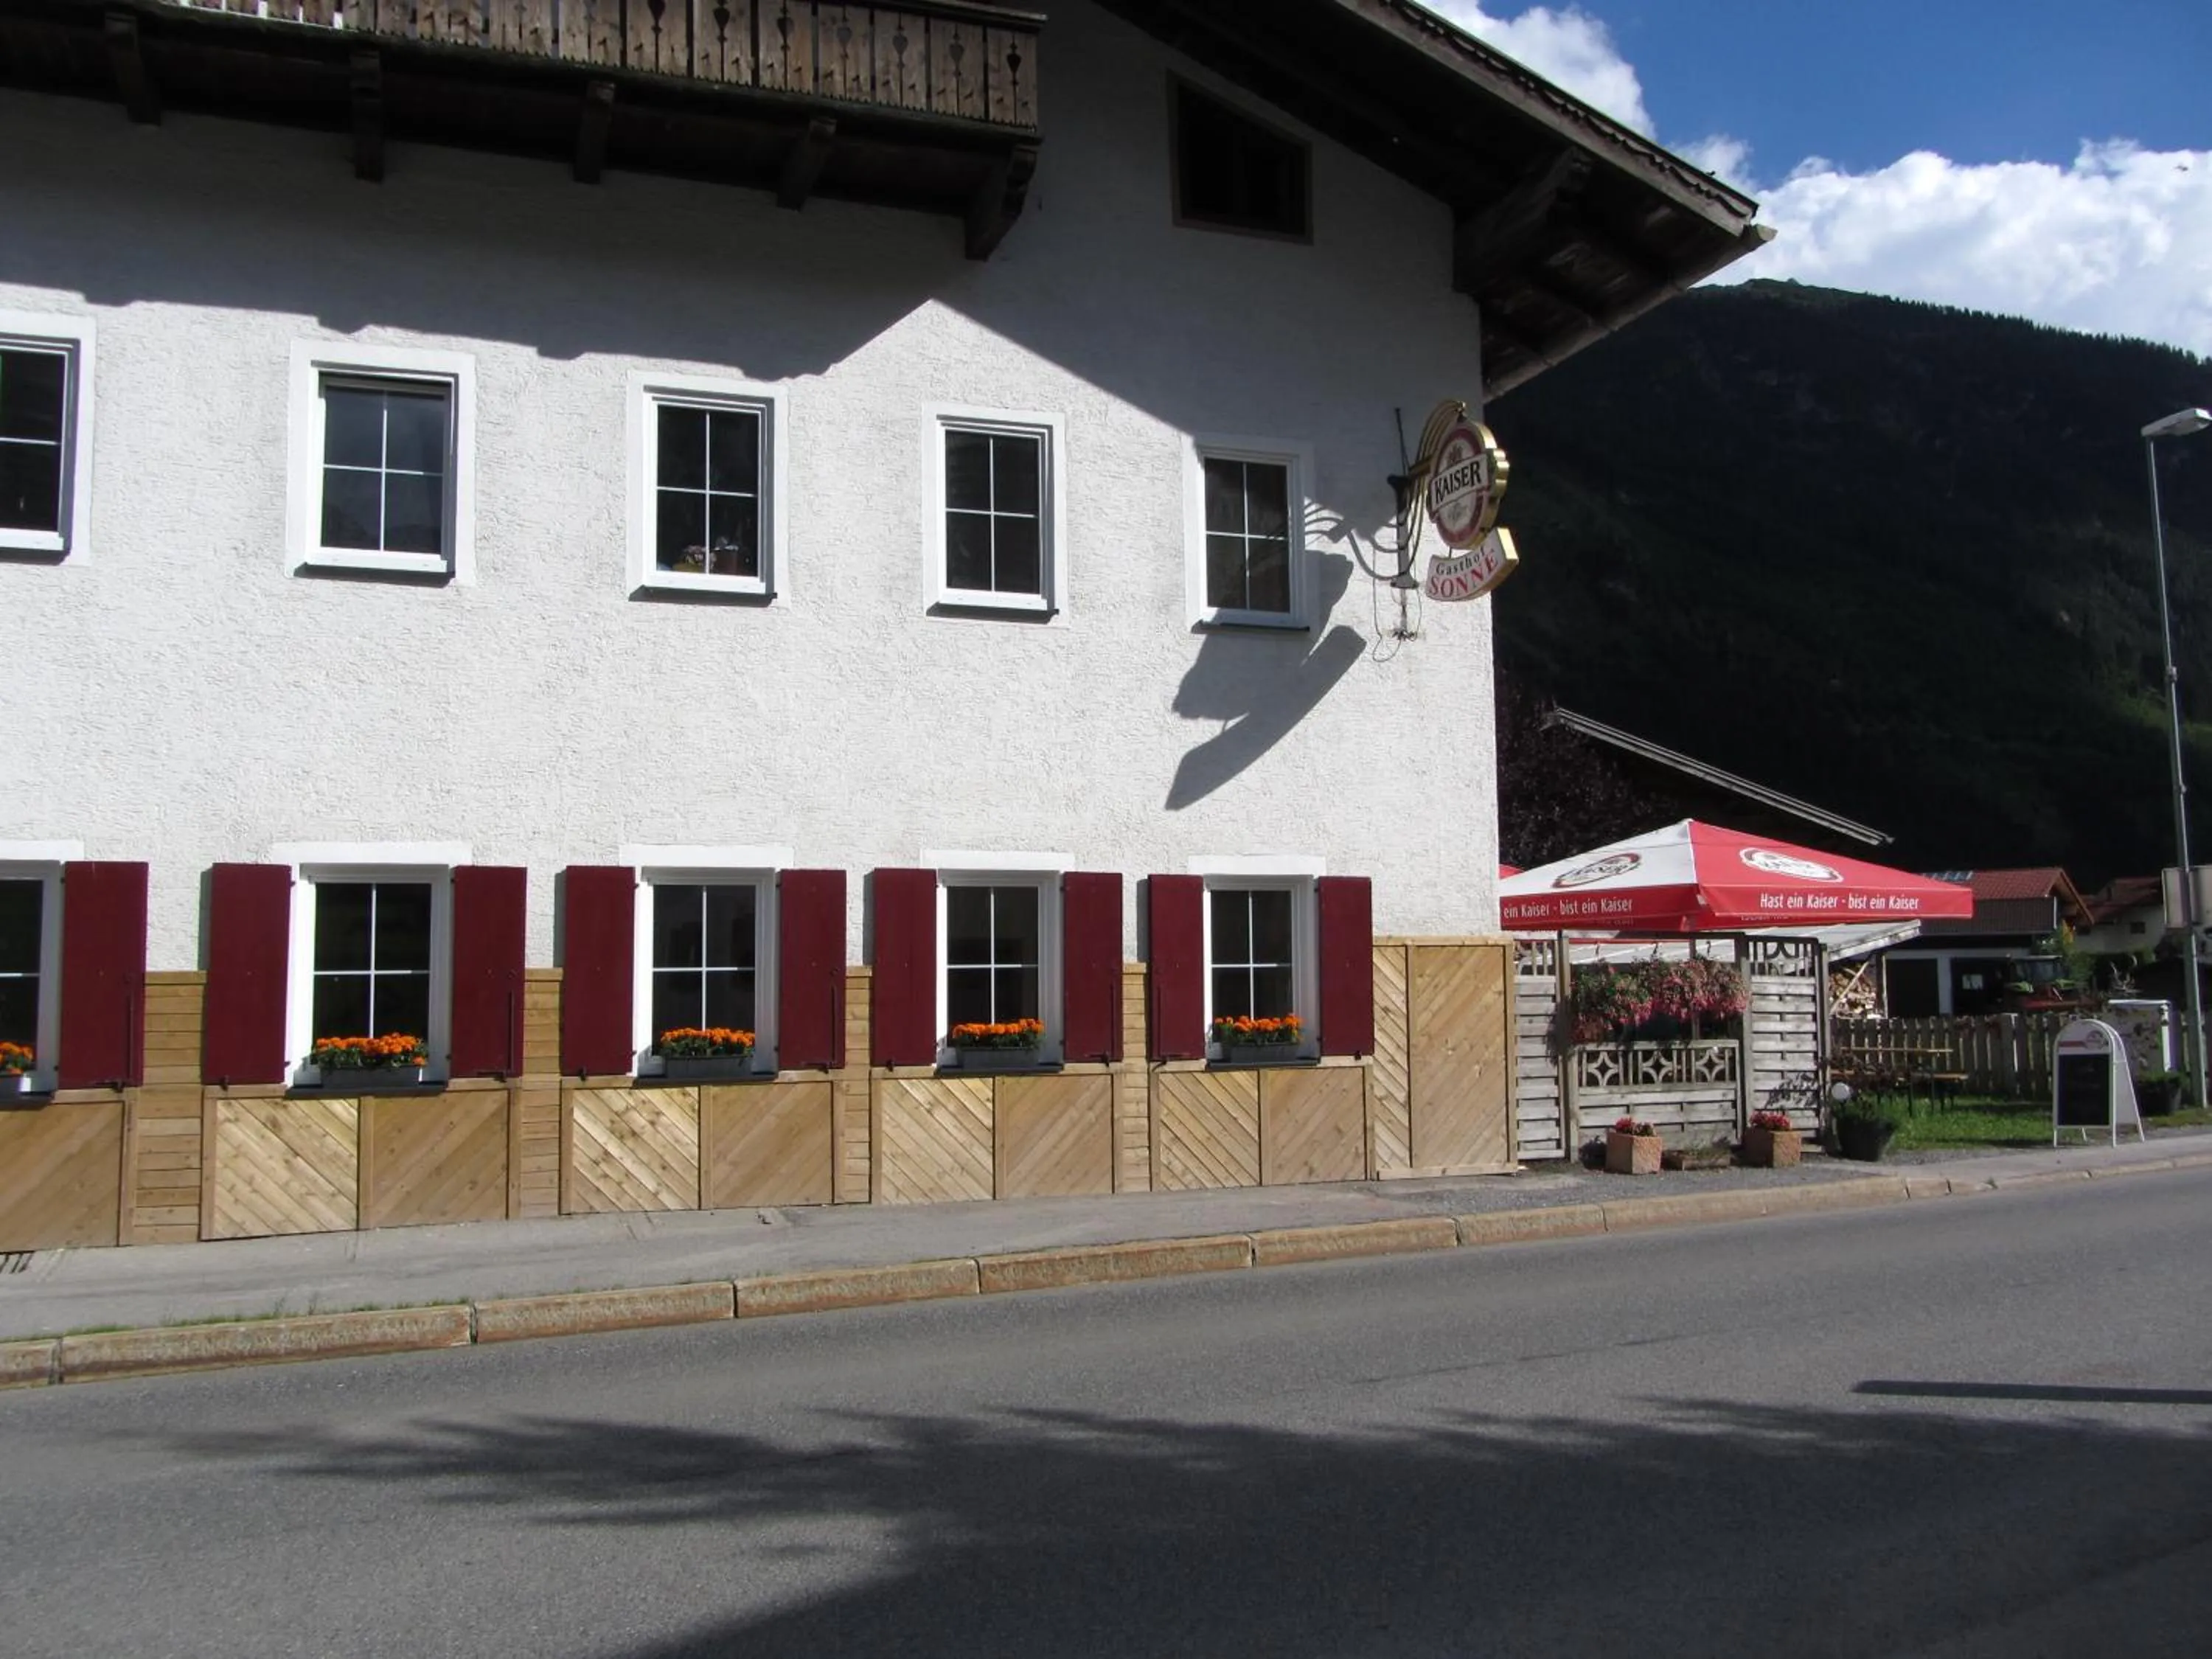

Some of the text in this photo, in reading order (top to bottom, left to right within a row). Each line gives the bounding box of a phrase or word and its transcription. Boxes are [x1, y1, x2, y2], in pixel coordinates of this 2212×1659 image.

[1434, 461, 1481, 504] KAISER
[1430, 549, 1499, 597] SONNE
[1503, 906, 1518, 919] ein
[1521, 902, 1549, 918] Kaiser
[1559, 899, 1579, 915] bist
[1582, 898, 1598, 914] ein
[1601, 896, 1633, 914] Kaiser
[1760, 892, 1784, 908] Hast
[1787, 891, 1803, 908] ein
[1806, 892, 1838, 908] Kaiser
[1848, 893, 1867, 909] bist
[1870, 894, 1885, 909] ein
[1888, 894, 1919, 909] Kaiser
